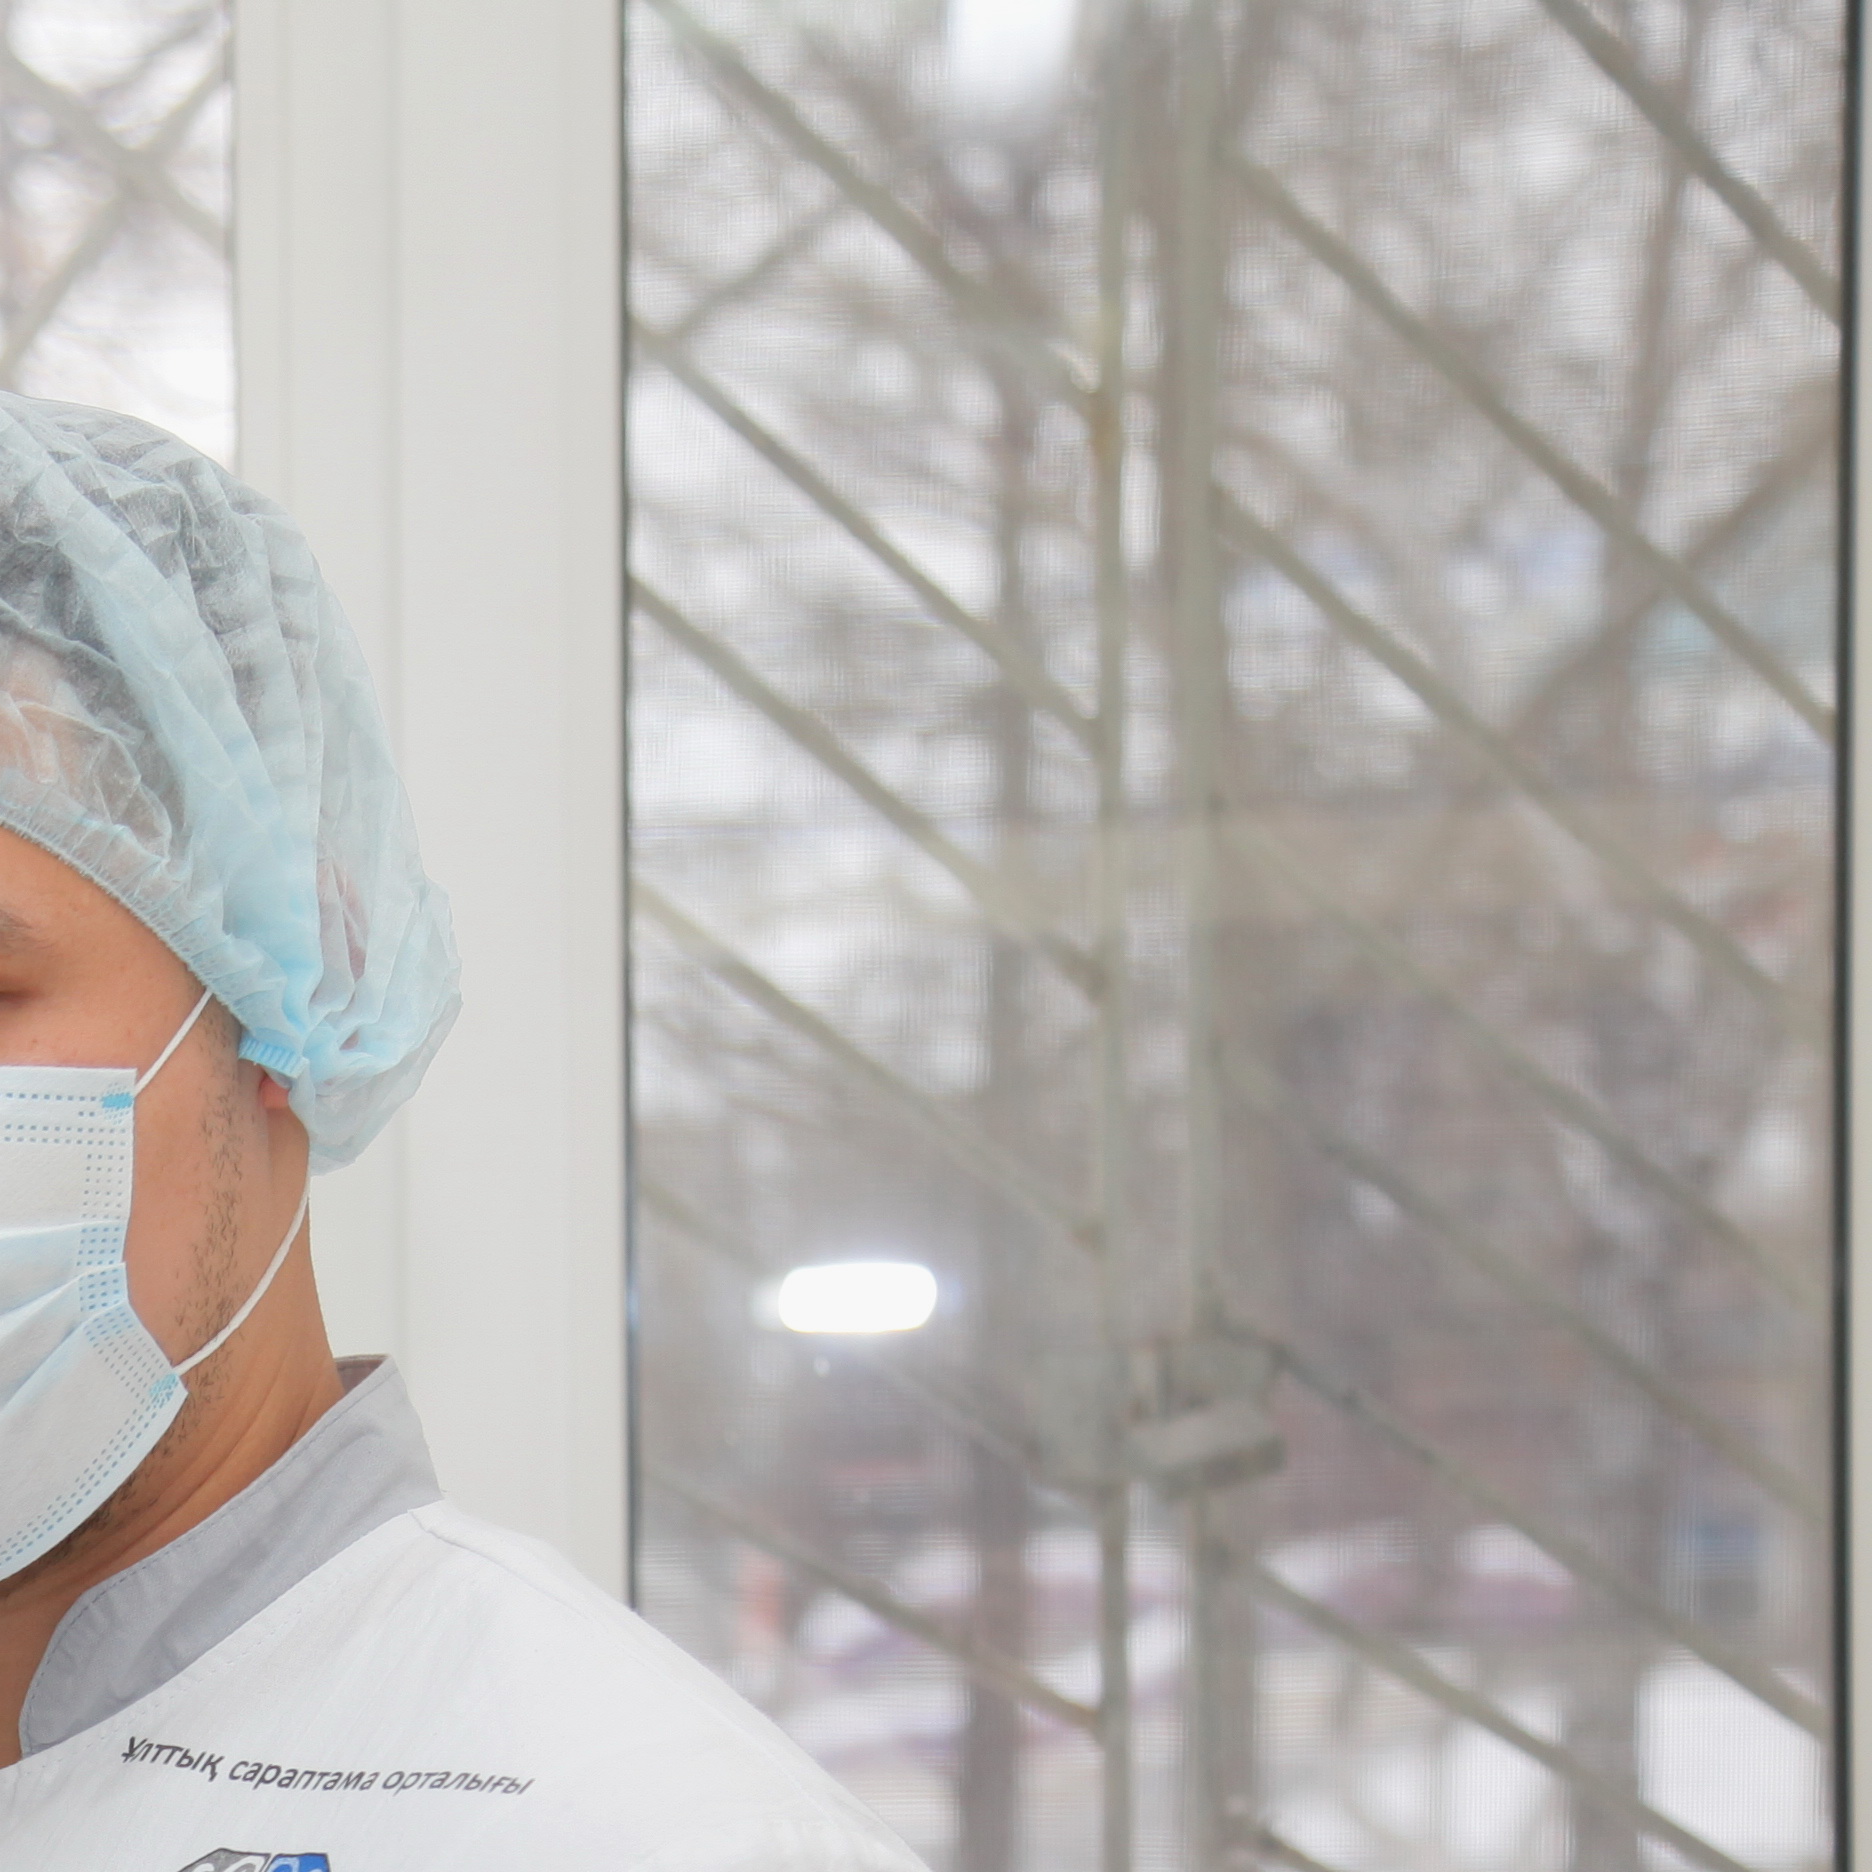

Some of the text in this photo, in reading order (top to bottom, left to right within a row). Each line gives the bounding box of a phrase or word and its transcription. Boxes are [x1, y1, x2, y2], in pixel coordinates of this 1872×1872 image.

[121, 1735, 535, 1798] Ұлттық сараптама орталығы
